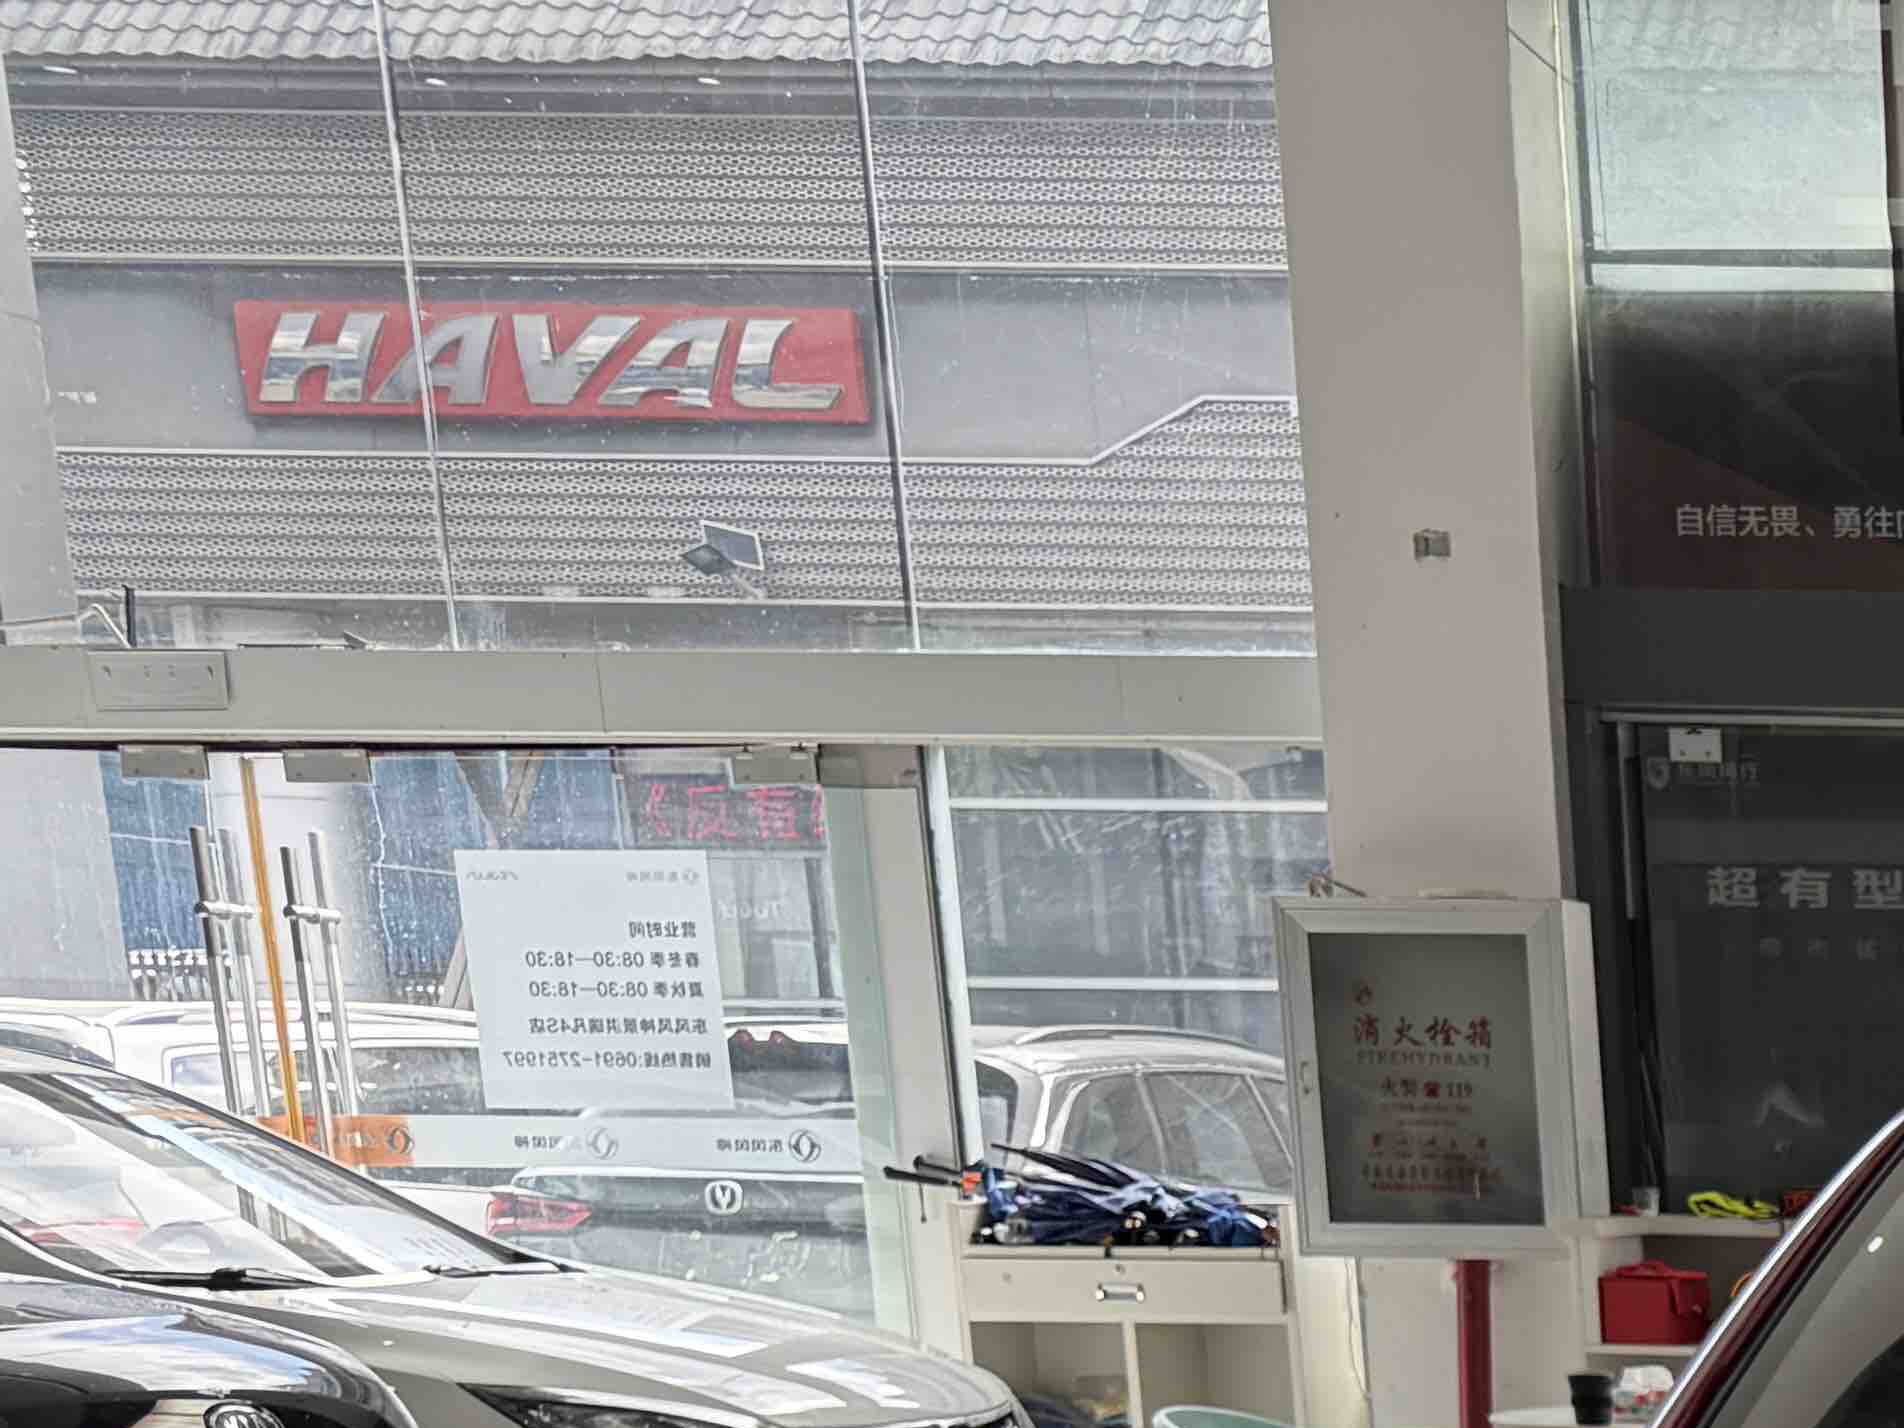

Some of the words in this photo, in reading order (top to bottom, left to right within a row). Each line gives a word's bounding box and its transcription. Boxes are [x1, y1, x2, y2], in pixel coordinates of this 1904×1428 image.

[258, 310, 845, 411] HAVAL
[1352, 1014, 1492, 1049] 消火栓箱
